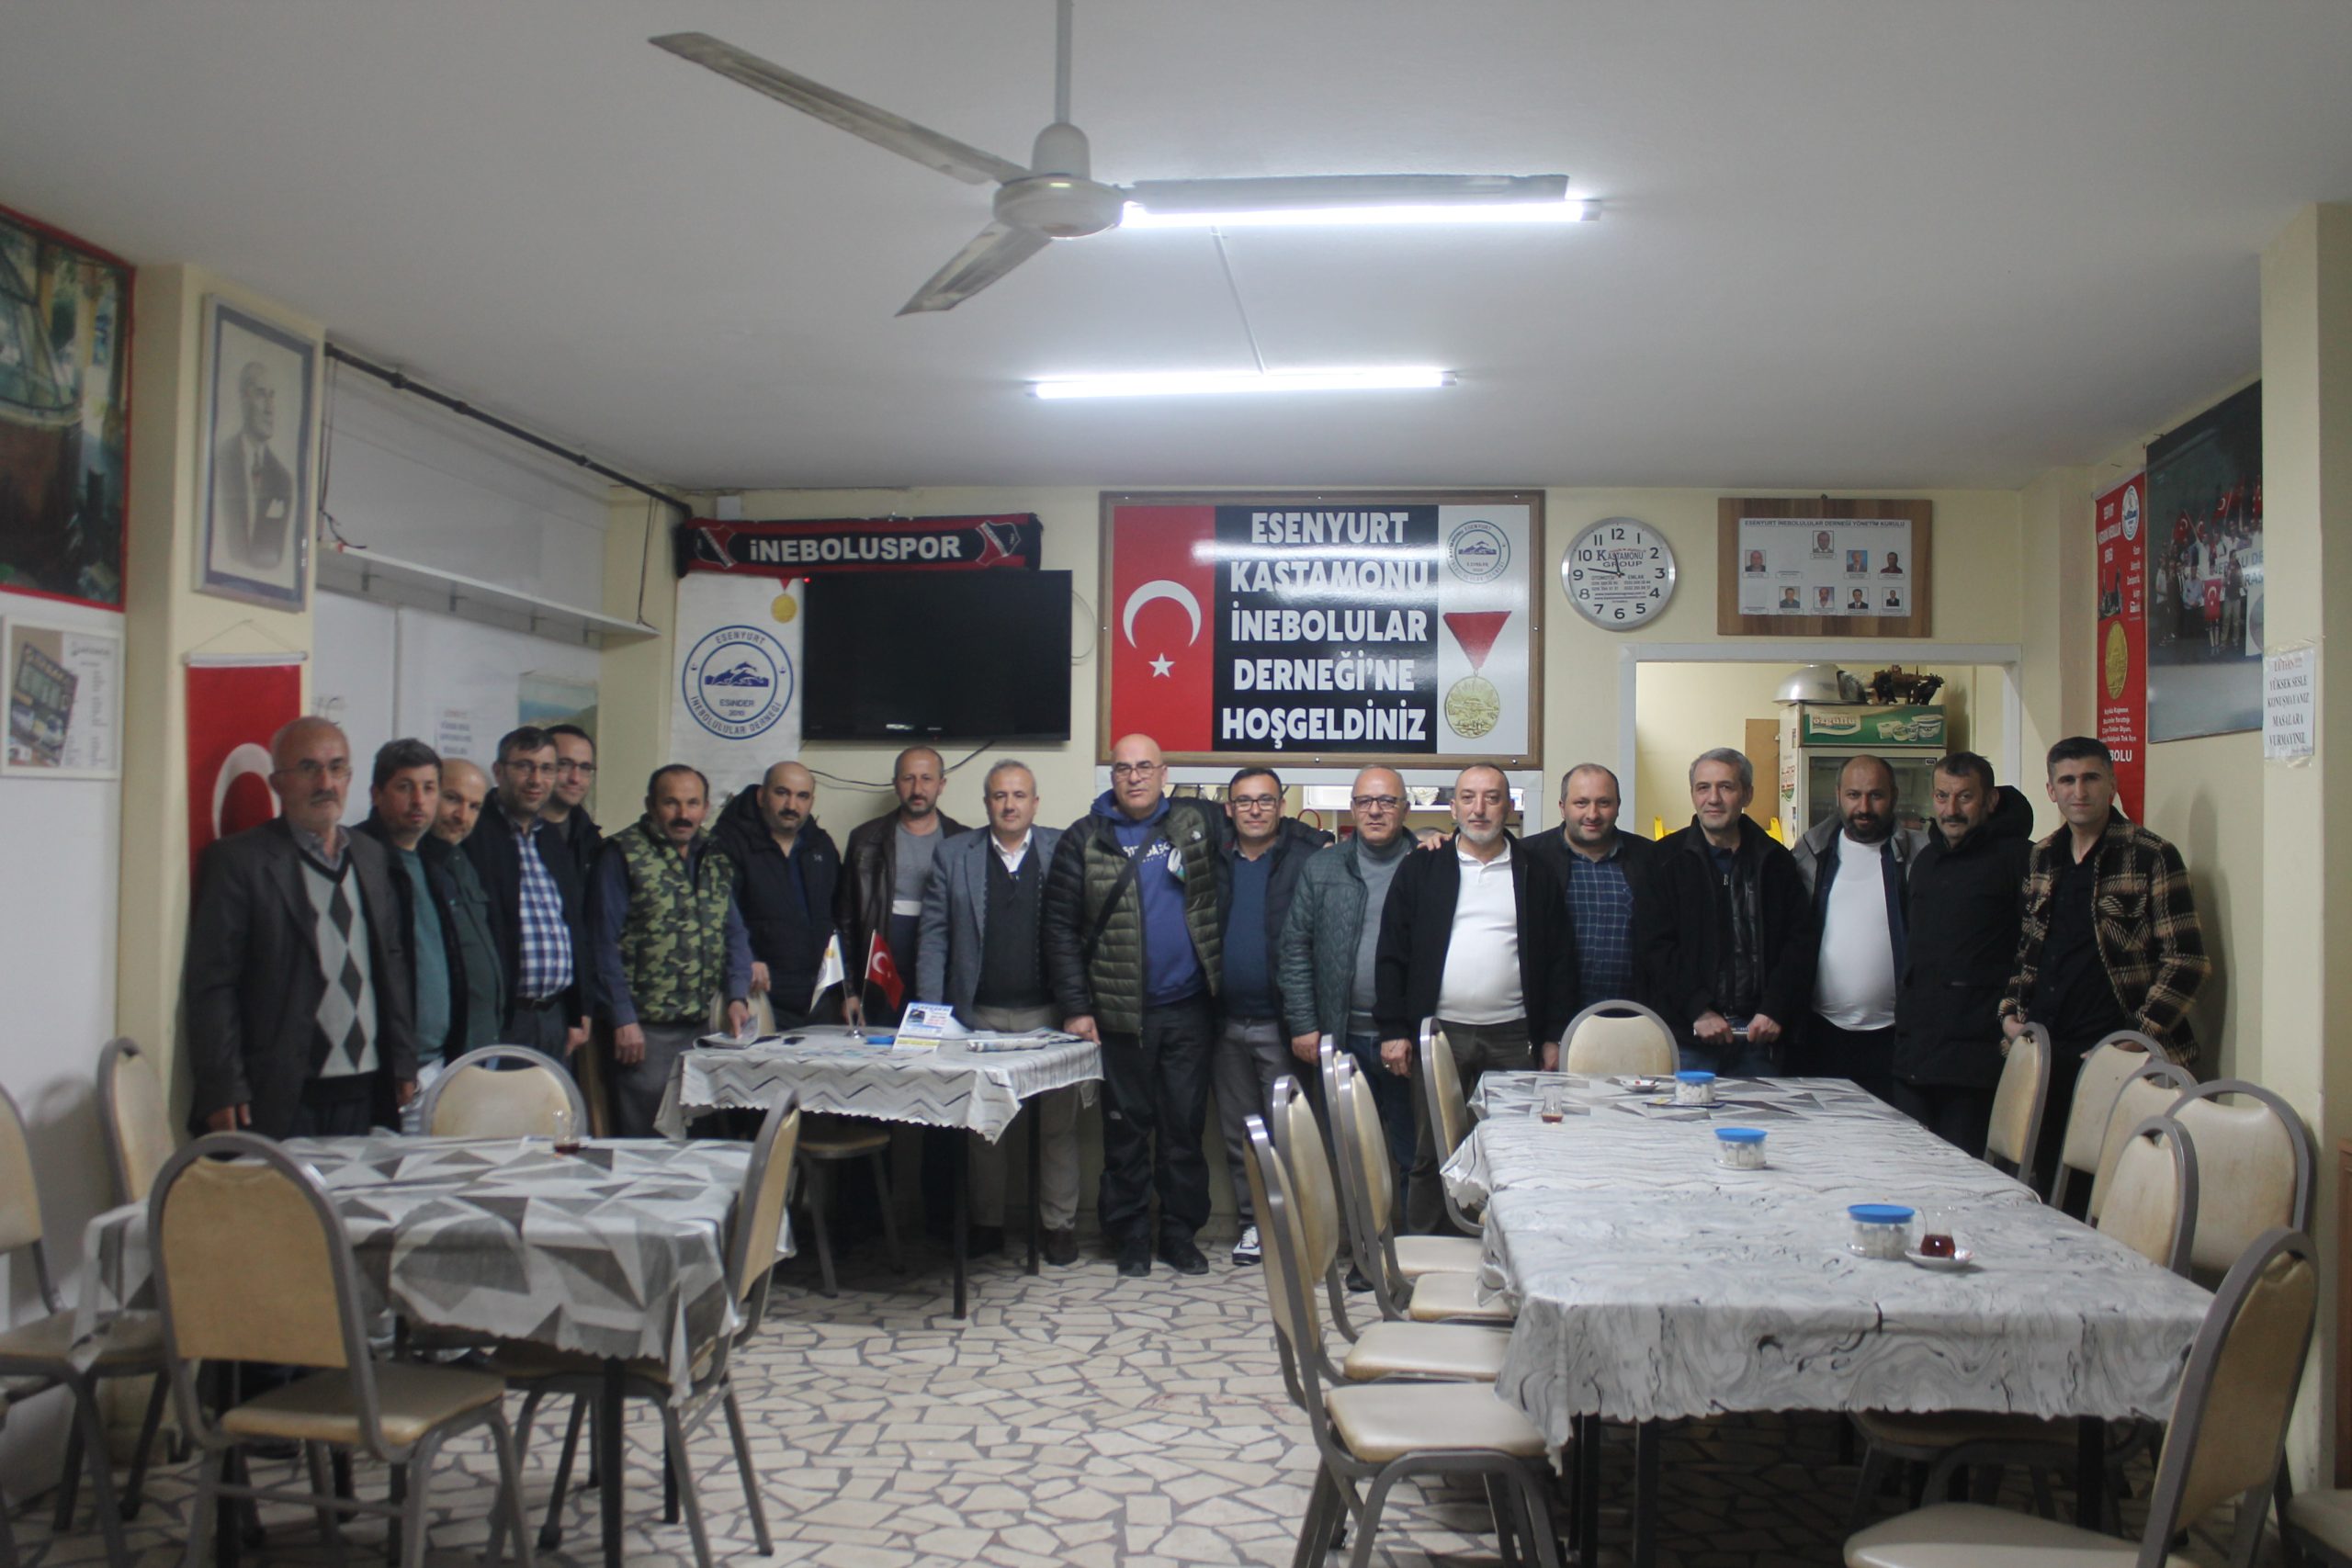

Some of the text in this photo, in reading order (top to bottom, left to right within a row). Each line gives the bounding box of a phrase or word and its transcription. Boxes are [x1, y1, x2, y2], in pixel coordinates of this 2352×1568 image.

[1252, 513, 1408, 544] ESENYURT
[1611, 528, 1625, 540] 12
[1594, 534, 1603, 546] 11
[1578, 549, 1592, 561] 10
[1649, 547, 1659, 559] 2
[1230, 561, 1429, 592] KASTAMONU
[1573, 570, 1584, 581] 9
[1655, 568, 1666, 580] 3
[1579, 588, 1590, 600] 8
[1649, 588, 1660, 599] 4
[1594, 604, 1604, 615] 7
[1614, 608, 1625, 620] 6
[1635, 603, 1646, 615] 5
[1231, 601, 1427, 642] İNEBOLULAR
[715, 631, 766, 645] ESENYURT
[1223, 699, 1427, 750] HOŞGELDİNİZ
